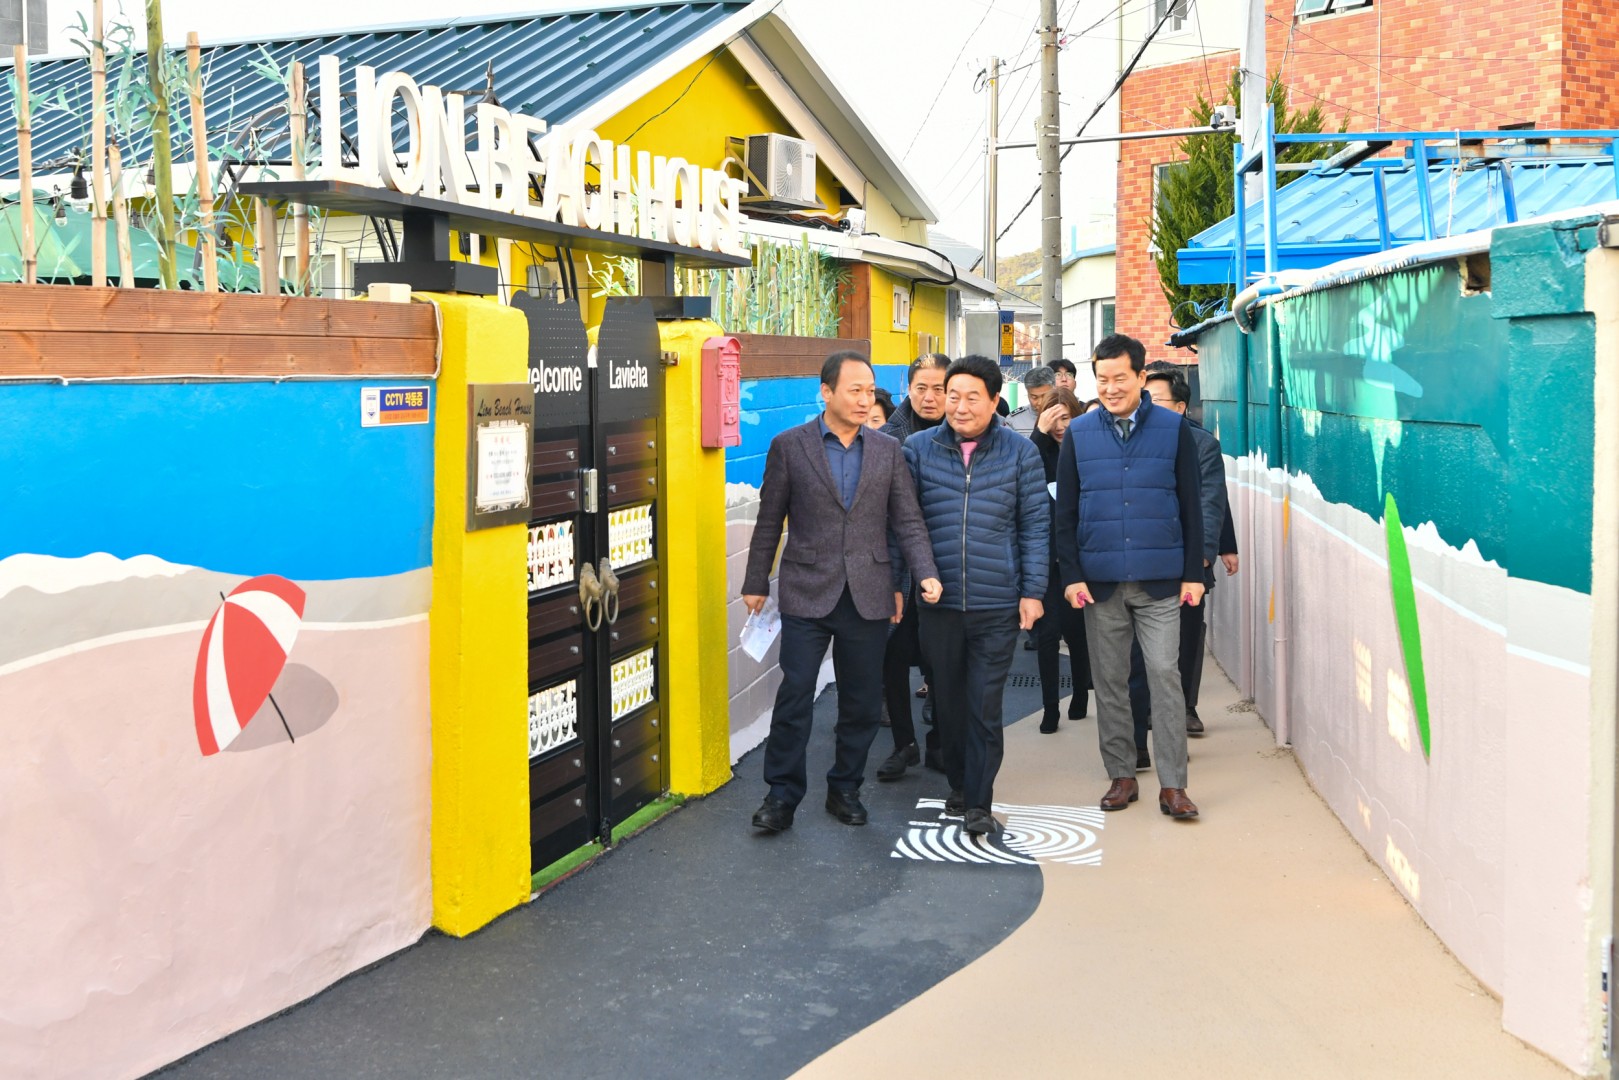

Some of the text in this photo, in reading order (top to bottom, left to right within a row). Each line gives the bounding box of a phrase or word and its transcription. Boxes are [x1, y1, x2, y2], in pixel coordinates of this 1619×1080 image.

[319, 54, 751, 260] LION BEACH HOUSE
[527, 360, 582, 393] elcome
[610, 360, 648, 389] Lavieha
[385, 391, 423, 407] CCTV 작동중
[477, 398, 492, 416] Lion
[495, 398, 512, 416] Beach
